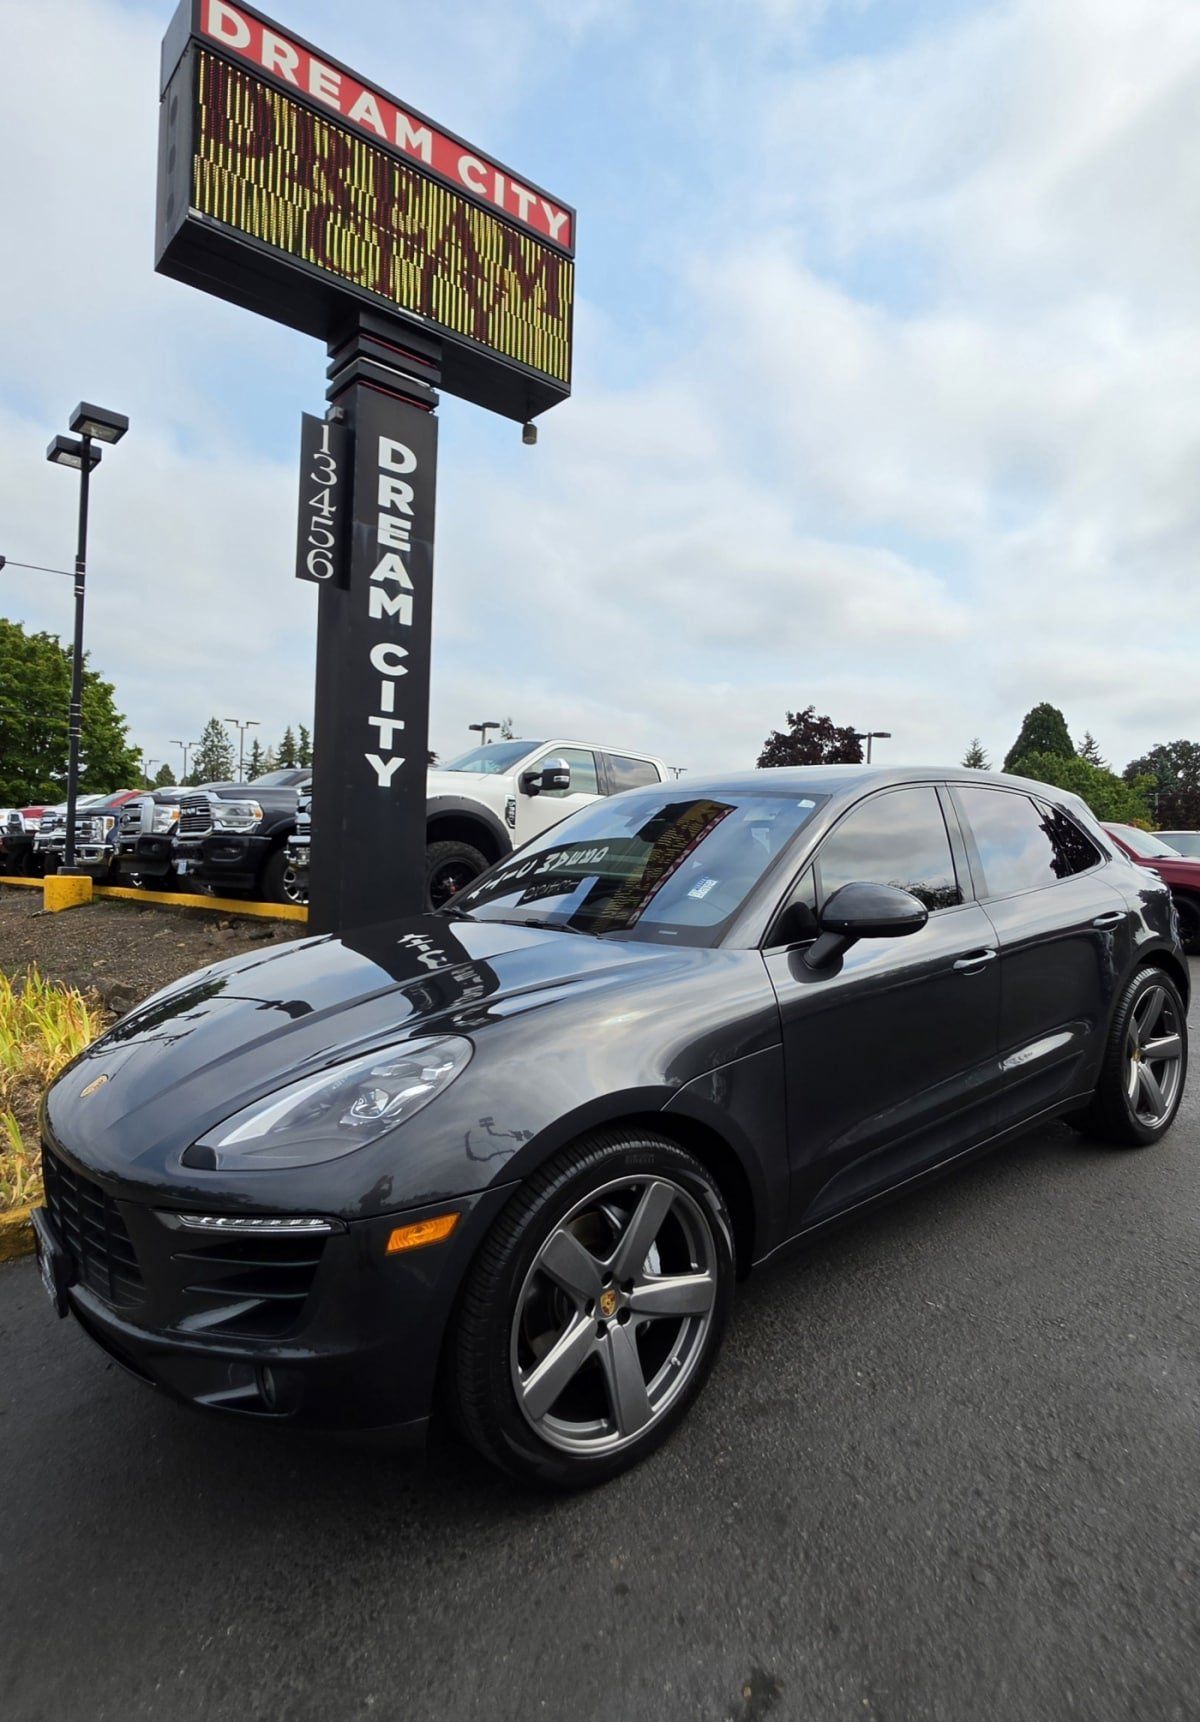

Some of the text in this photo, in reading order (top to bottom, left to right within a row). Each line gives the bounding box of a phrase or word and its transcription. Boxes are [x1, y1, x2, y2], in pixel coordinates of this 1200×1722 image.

[207, 0, 569, 241] DREAM CITY
[306, 424, 338, 580] 13456
[364, 435, 418, 788] DREAM CITY
